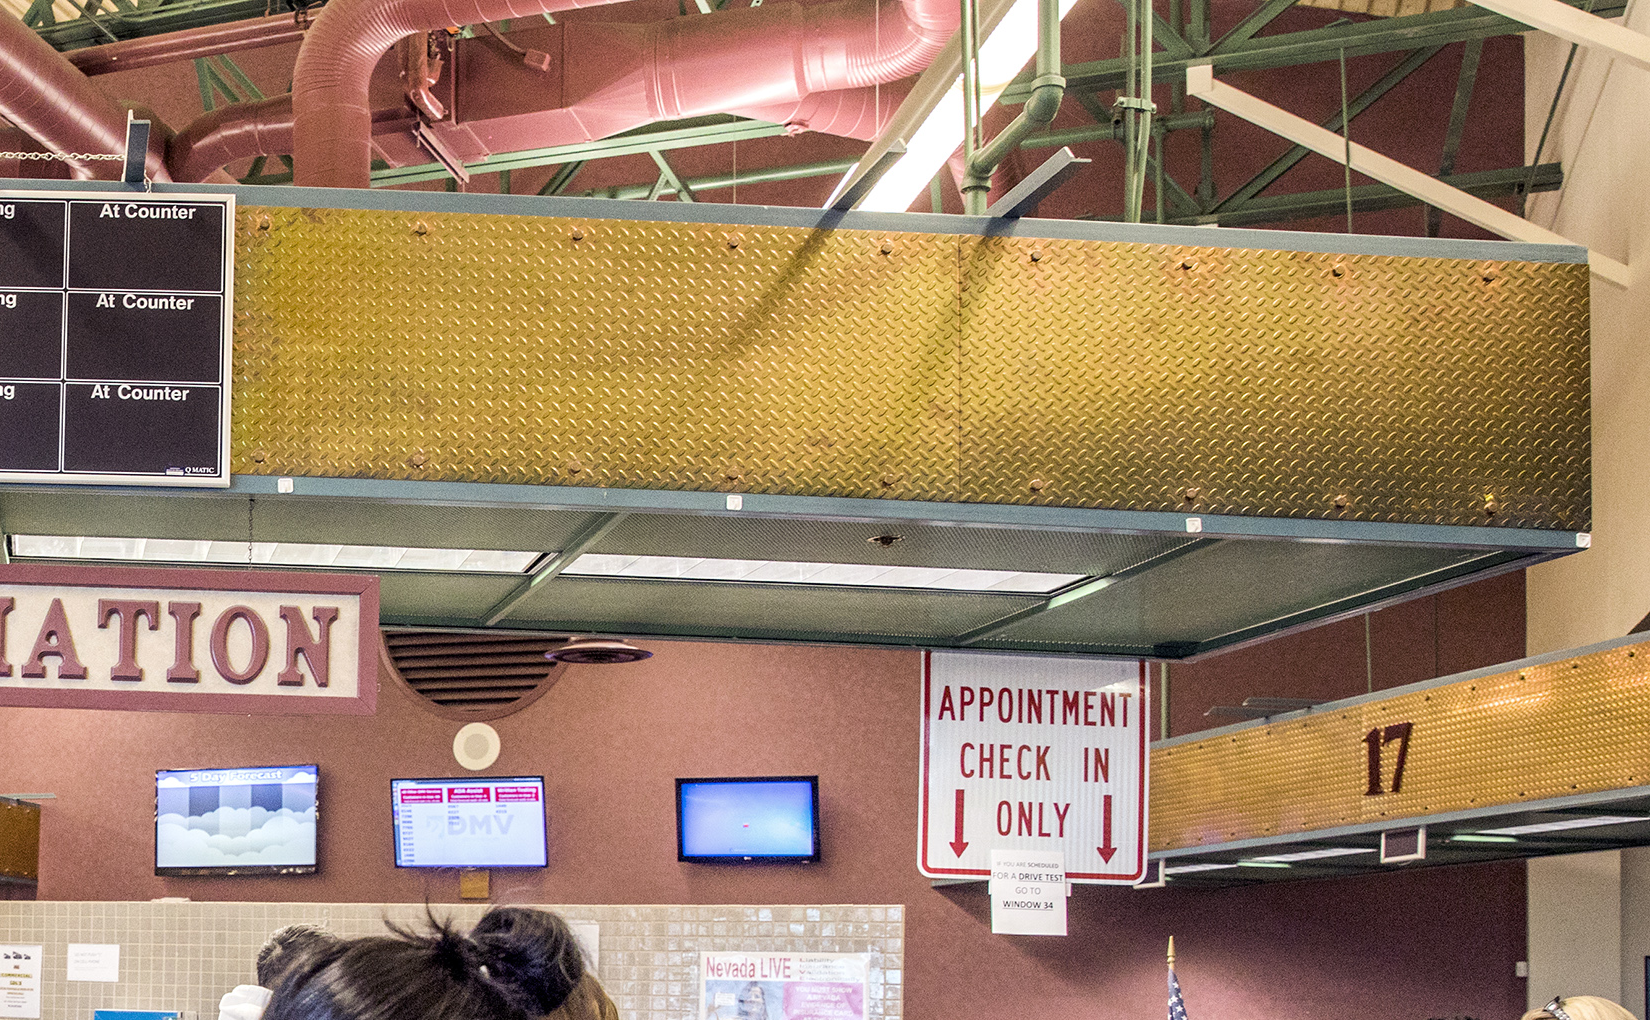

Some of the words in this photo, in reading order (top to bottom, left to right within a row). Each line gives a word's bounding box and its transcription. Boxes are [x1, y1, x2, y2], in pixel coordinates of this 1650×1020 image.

[100, 204, 120, 218] At
[124, 204, 196, 219] Counter
[96, 293, 115, 308] At
[122, 294, 194, 310] Counter
[91, 384, 110, 399] At
[117, 384, 189, 401] Counter
[938, 685, 1132, 727] APPOINTMENT
[960, 742, 1050, 780] CHECK
[1084, 747, 1109, 783] IN
[1360, 723, 1413, 796] 17
[190, 771, 198, 782] 5
[202, 771, 226, 783] Day
[228, 770, 282, 780] Forecast
[447, 815, 514, 835] DMV
[996, 800, 1071, 837] ONLY
[1019, 873, 1043, 881] DRIVE
[1015, 886, 1028, 894] GO
[706, 957, 755, 978] Nevada
[760, 957, 792, 979] LIVE
